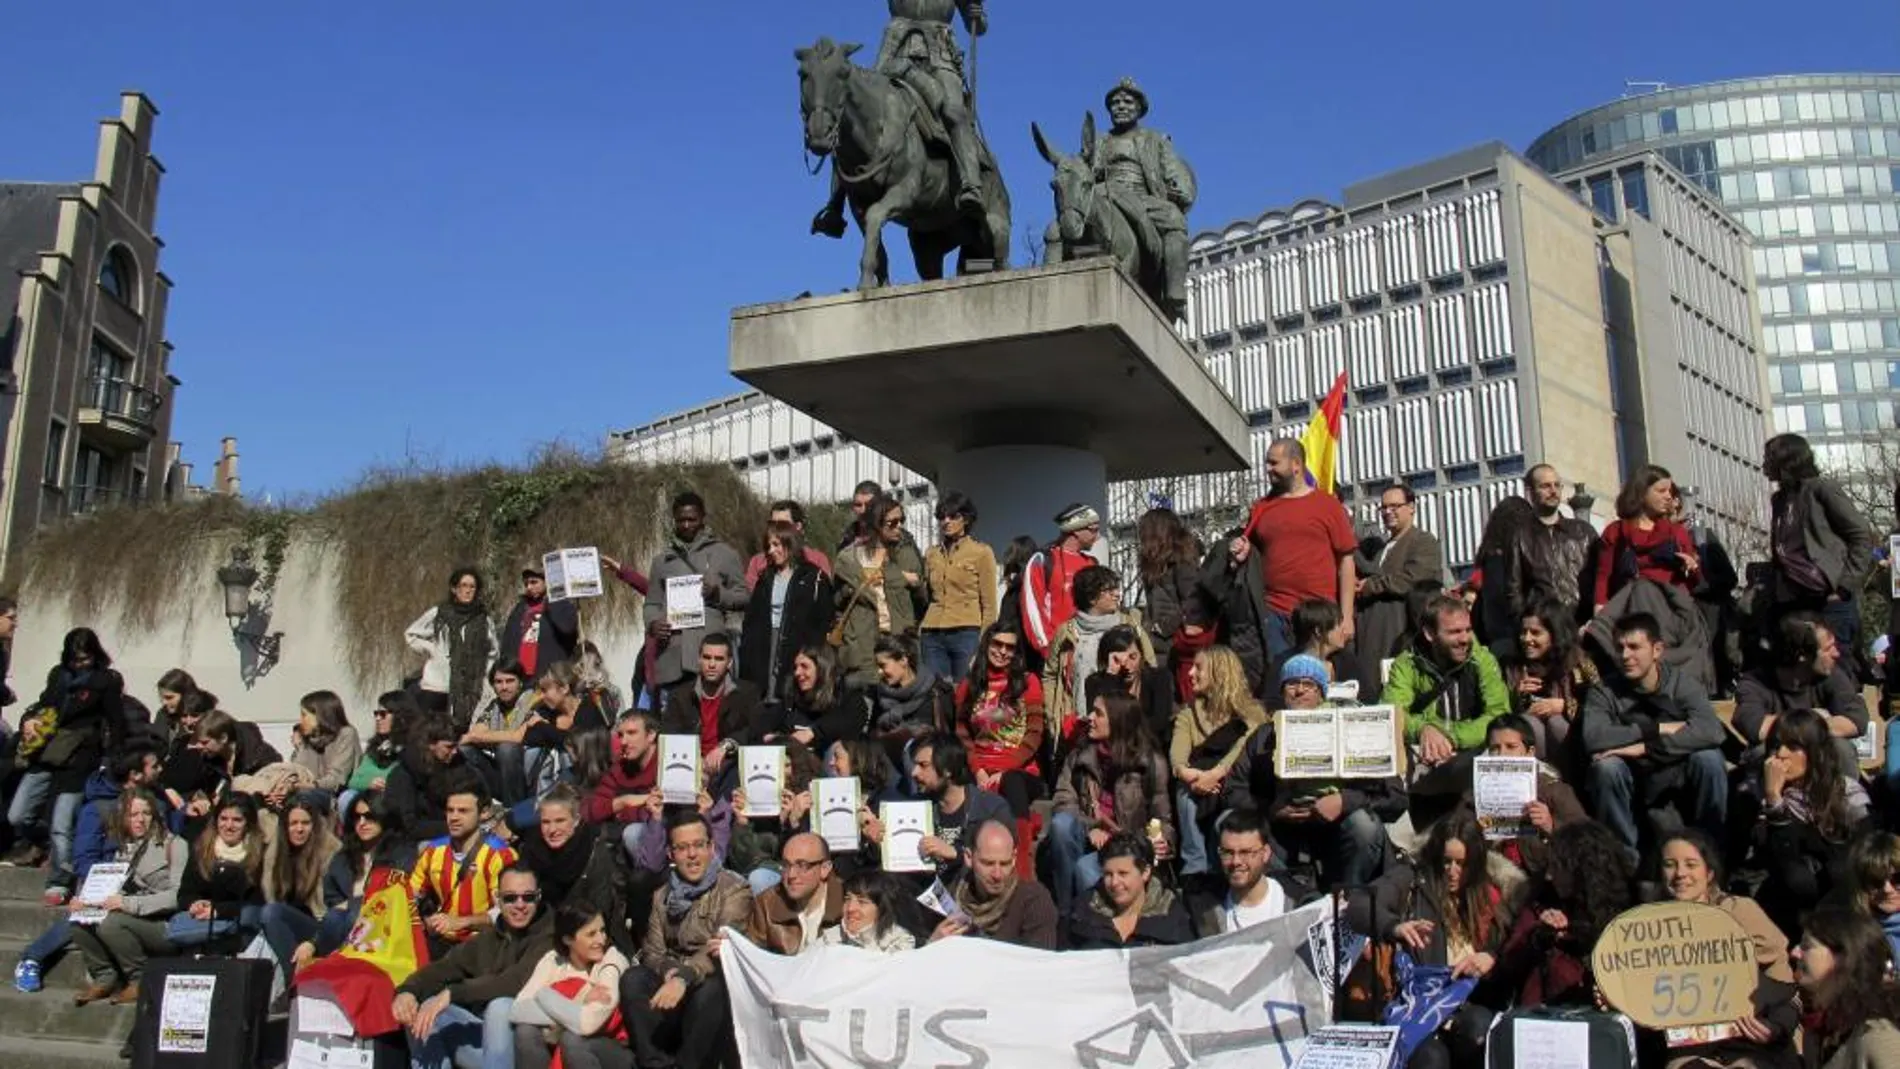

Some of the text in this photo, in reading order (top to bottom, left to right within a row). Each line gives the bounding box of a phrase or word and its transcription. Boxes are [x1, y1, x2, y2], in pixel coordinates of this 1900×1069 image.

[1619, 915, 1694, 942] YOUTH
[1600, 933, 1755, 974] UNEMPLOYMENT
[771, 1002, 990, 1069] TUS
